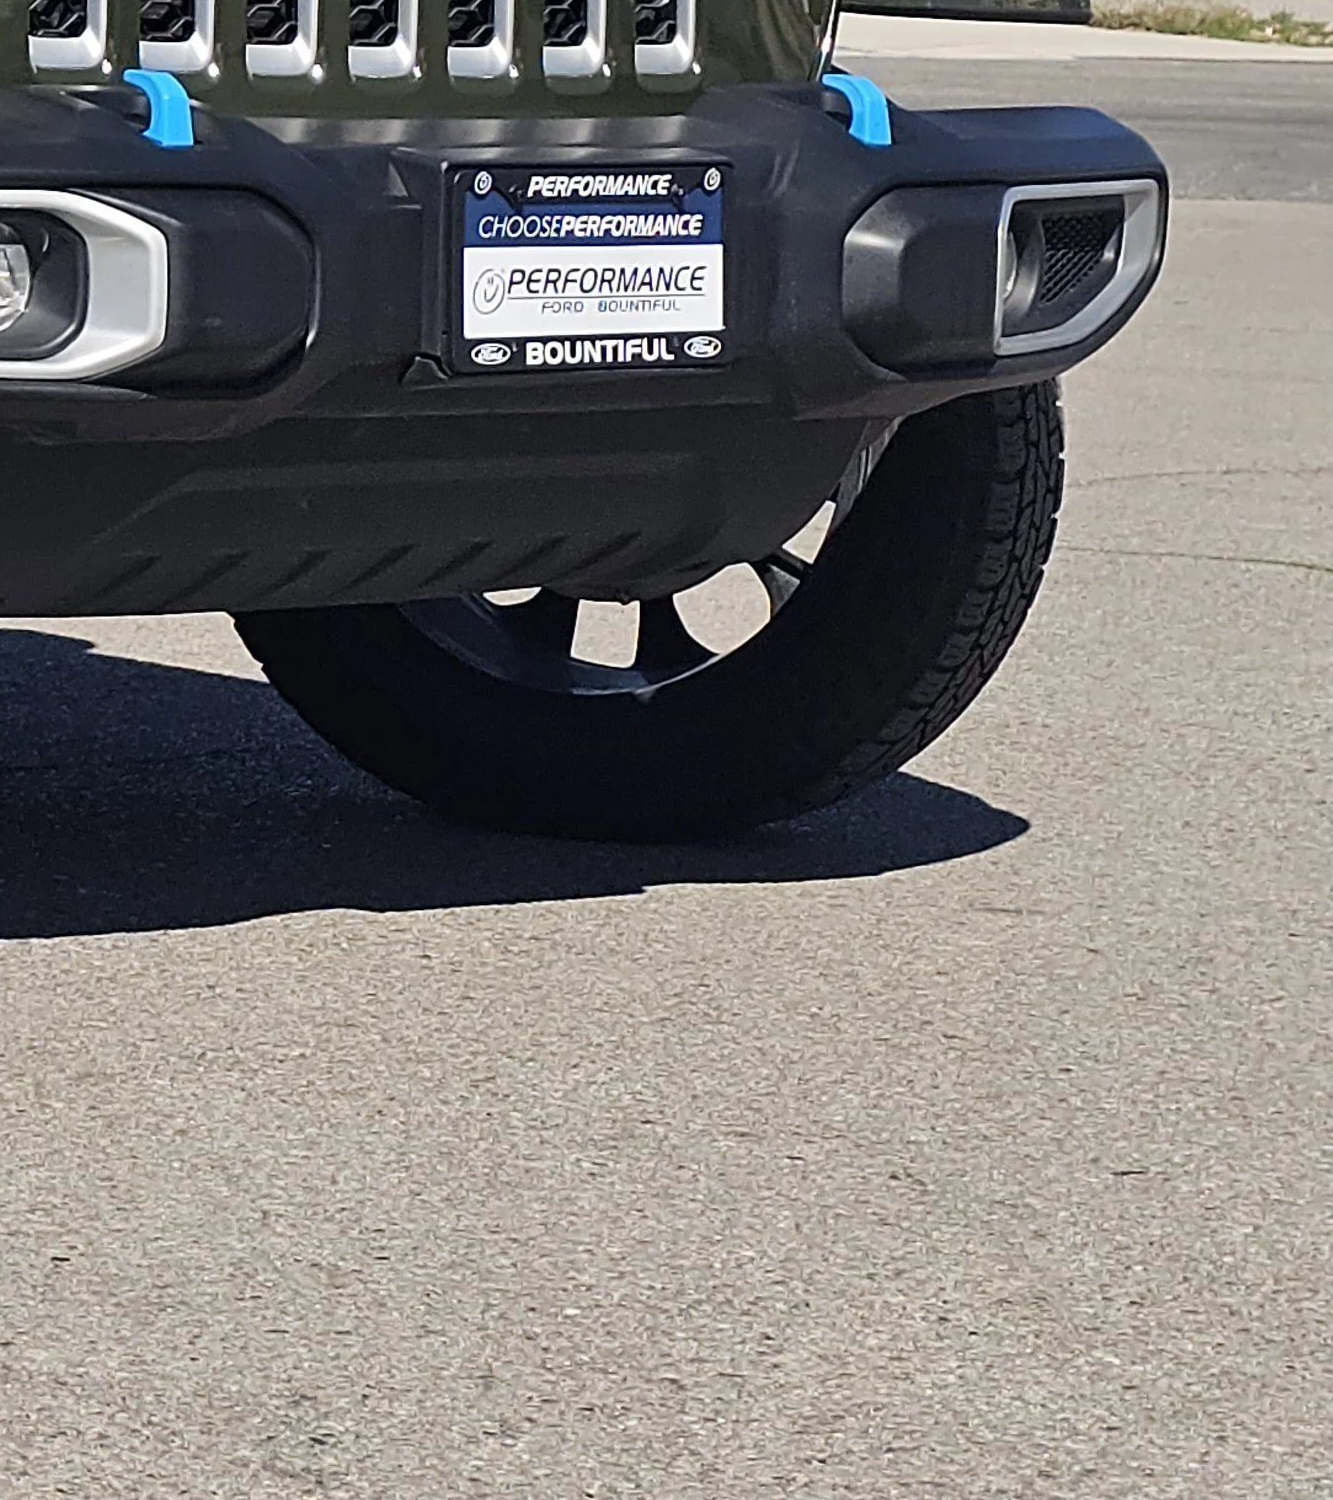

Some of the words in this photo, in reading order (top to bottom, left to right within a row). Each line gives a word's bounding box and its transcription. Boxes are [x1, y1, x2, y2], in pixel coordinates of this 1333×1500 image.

[527, 174, 672, 197] PERFORMANCE
[506, 265, 707, 294] PERFORMANCE
[541, 300, 584, 314] FORD
[597, 299, 681, 313] BOUNTIFUL
[525, 337, 675, 365] BOUNTIFUL
